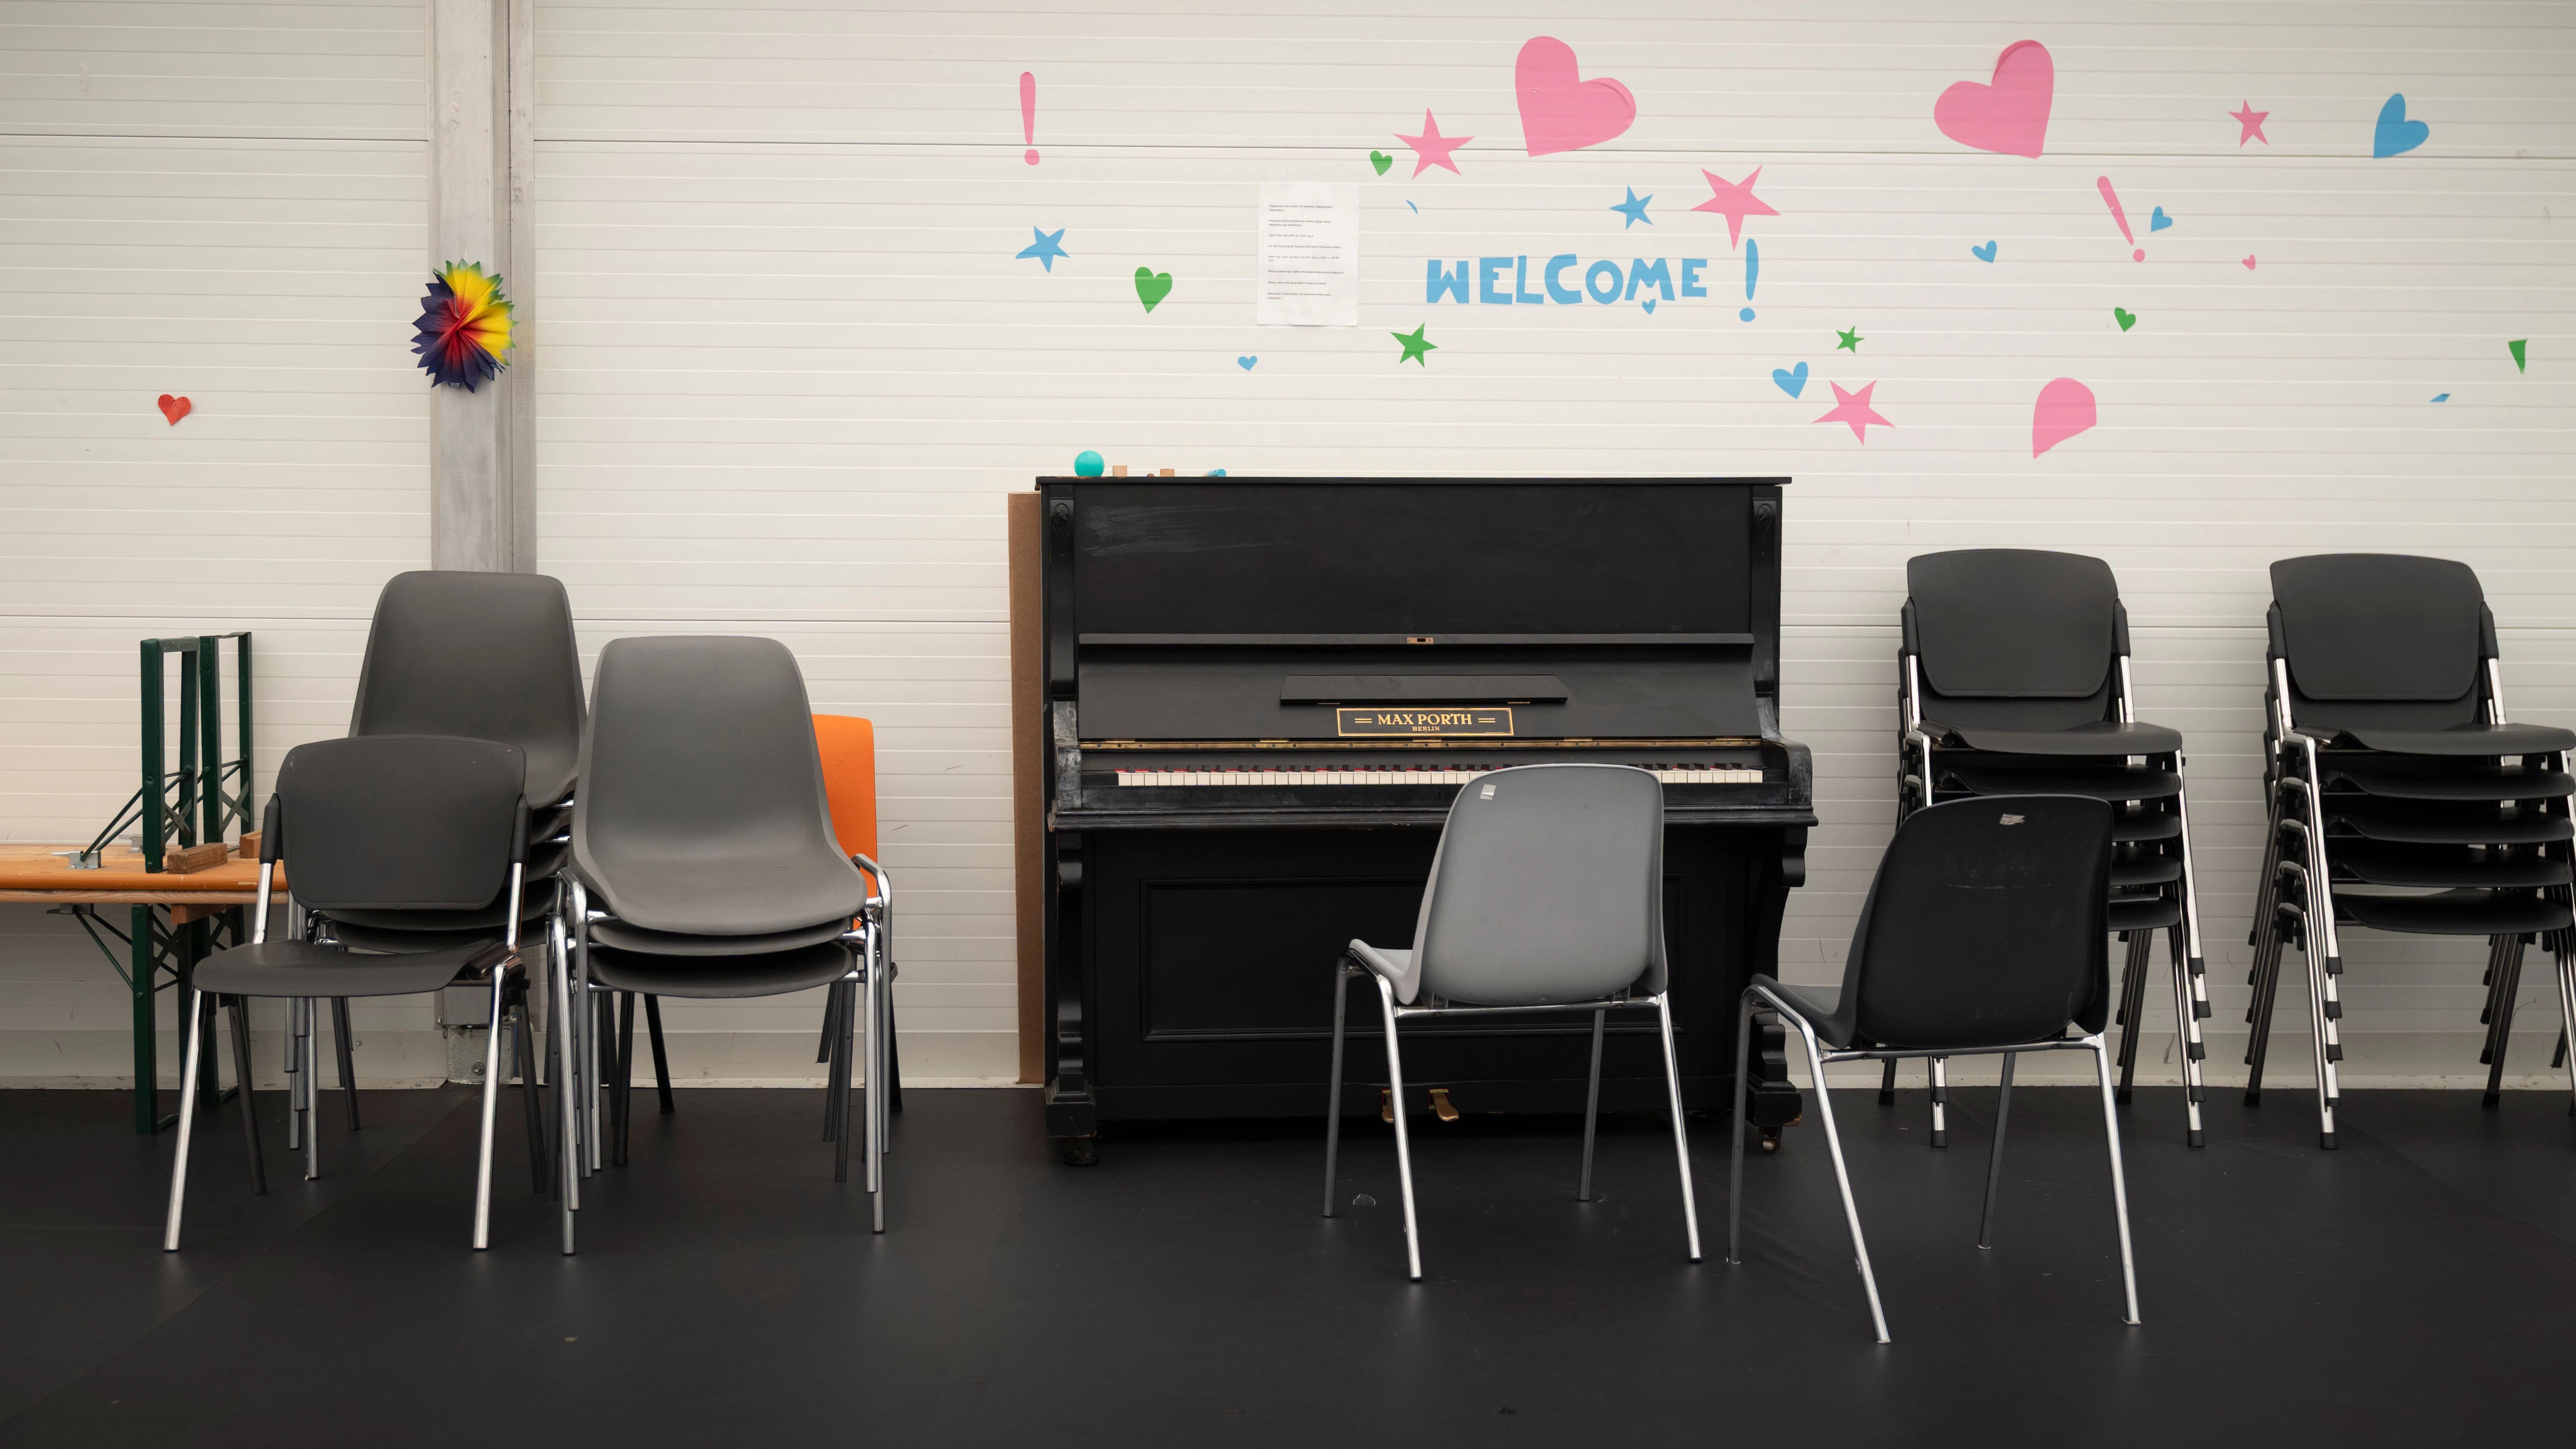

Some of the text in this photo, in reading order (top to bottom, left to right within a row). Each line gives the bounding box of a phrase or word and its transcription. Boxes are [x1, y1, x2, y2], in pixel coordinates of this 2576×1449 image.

[1426, 254, 1707, 304] WELCOME
[1377, 714, 1472, 725] MAX PORTH
